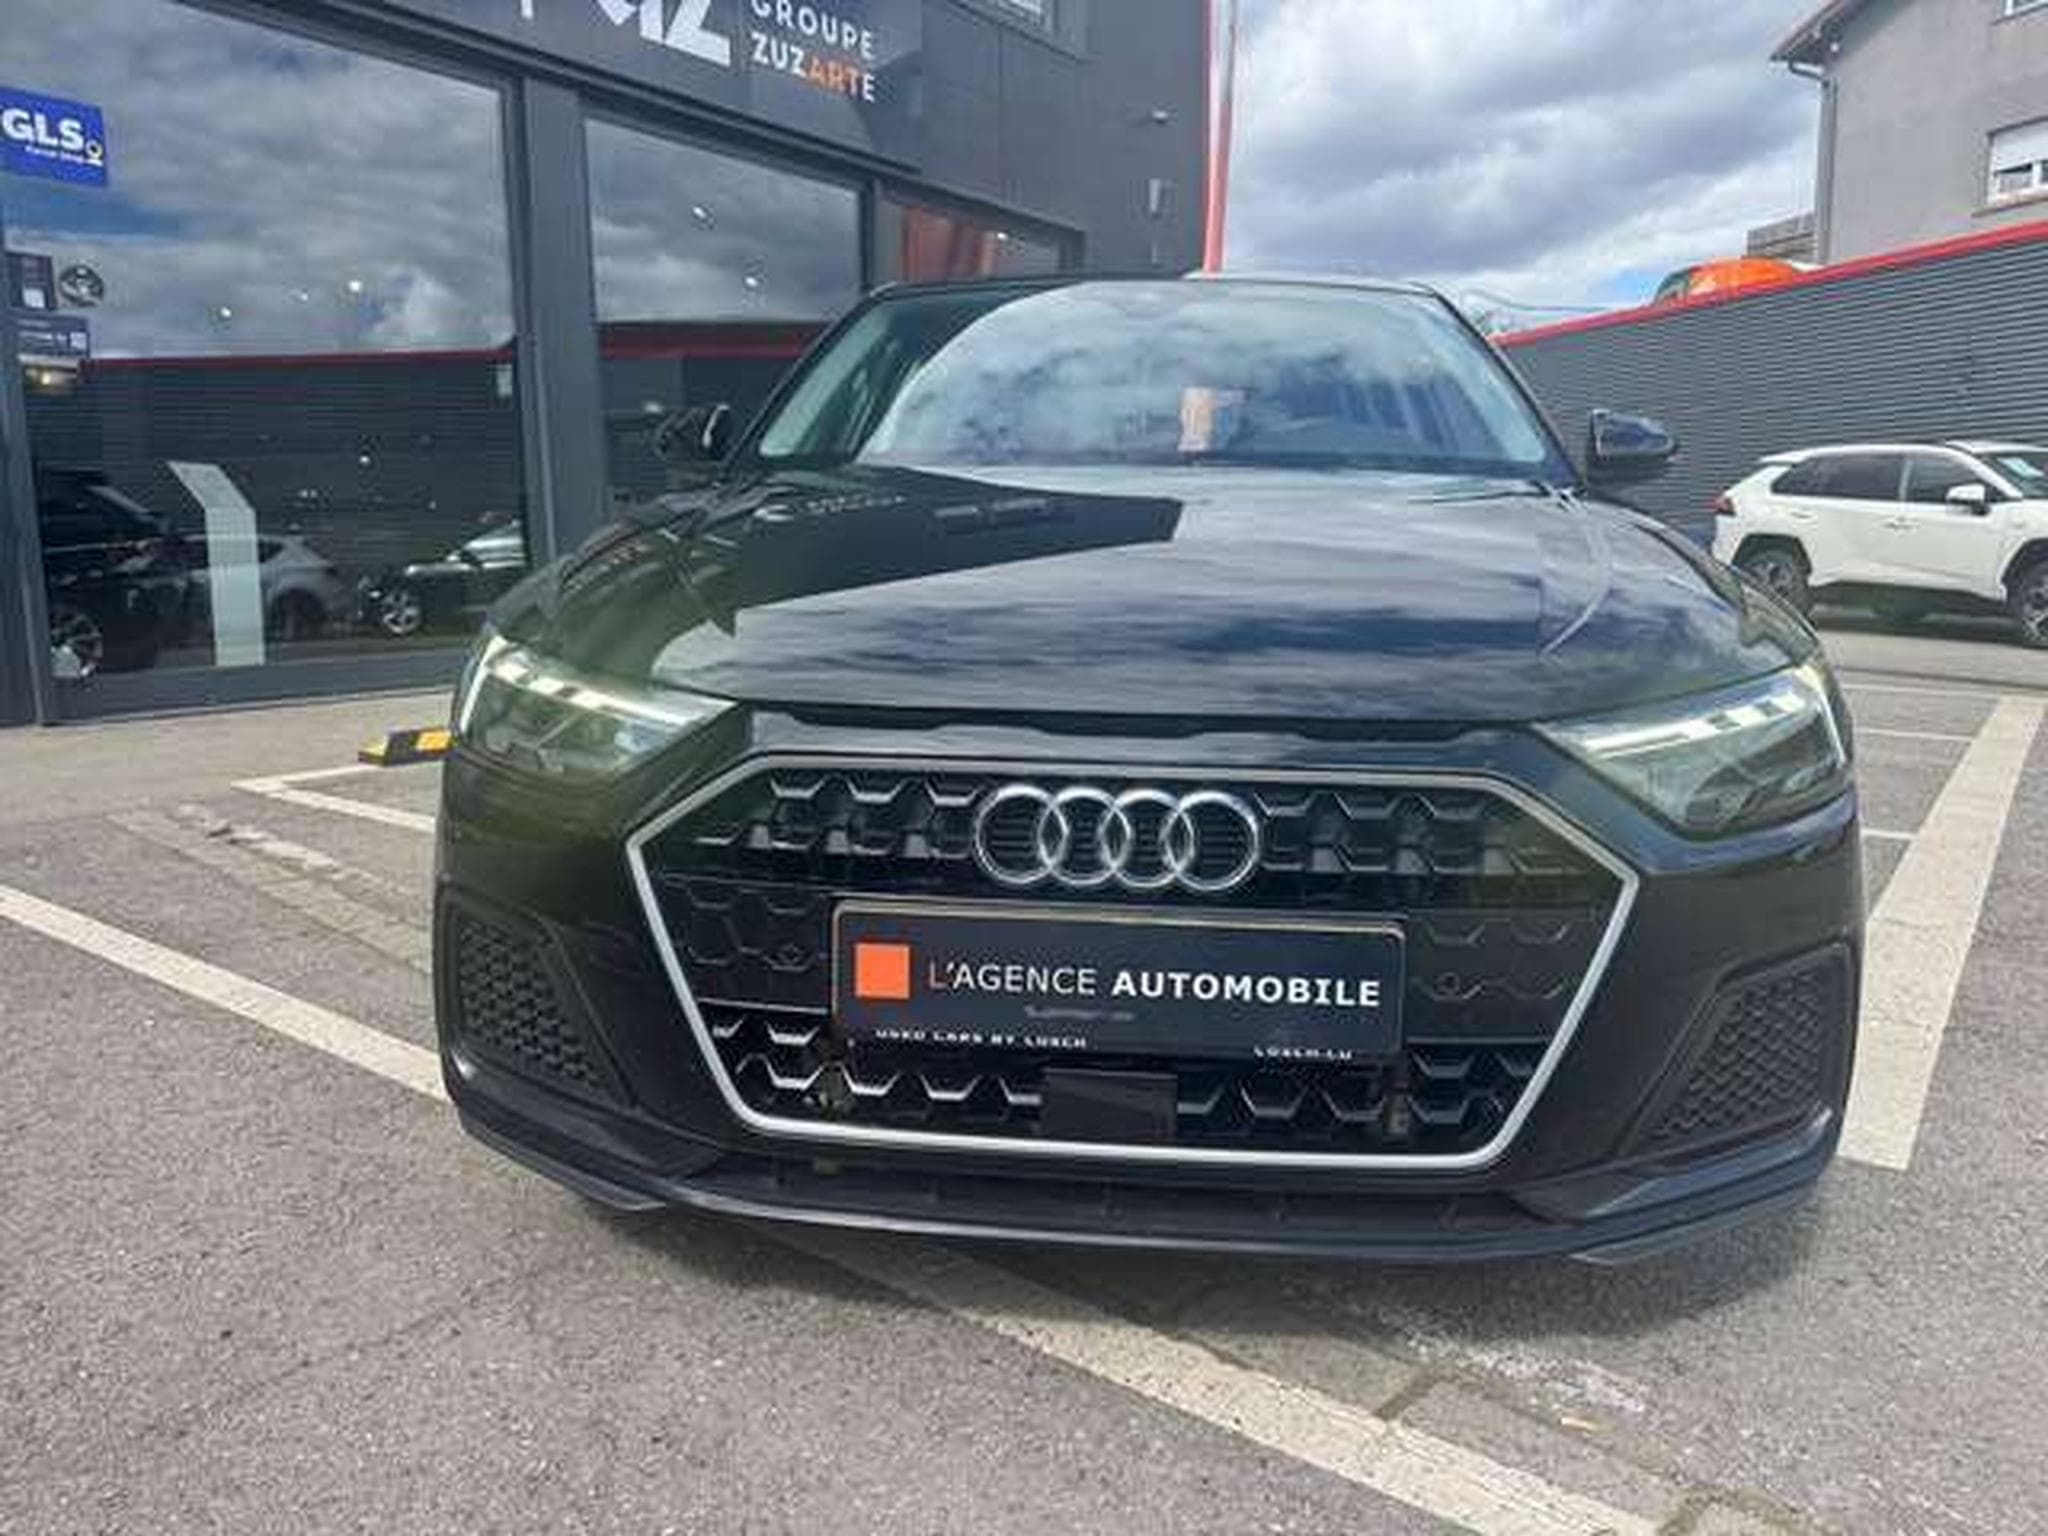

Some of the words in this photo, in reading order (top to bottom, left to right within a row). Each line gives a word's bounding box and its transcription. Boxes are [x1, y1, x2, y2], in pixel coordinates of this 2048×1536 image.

[751, 0, 876, 60] GROUPE
[751, 29, 875, 102] ZUZARTE
[2, 108, 84, 151] GLS
[929, 961, 1097, 995] L'AGENCE
[1111, 971, 1381, 1007] AUTOMOBILE
